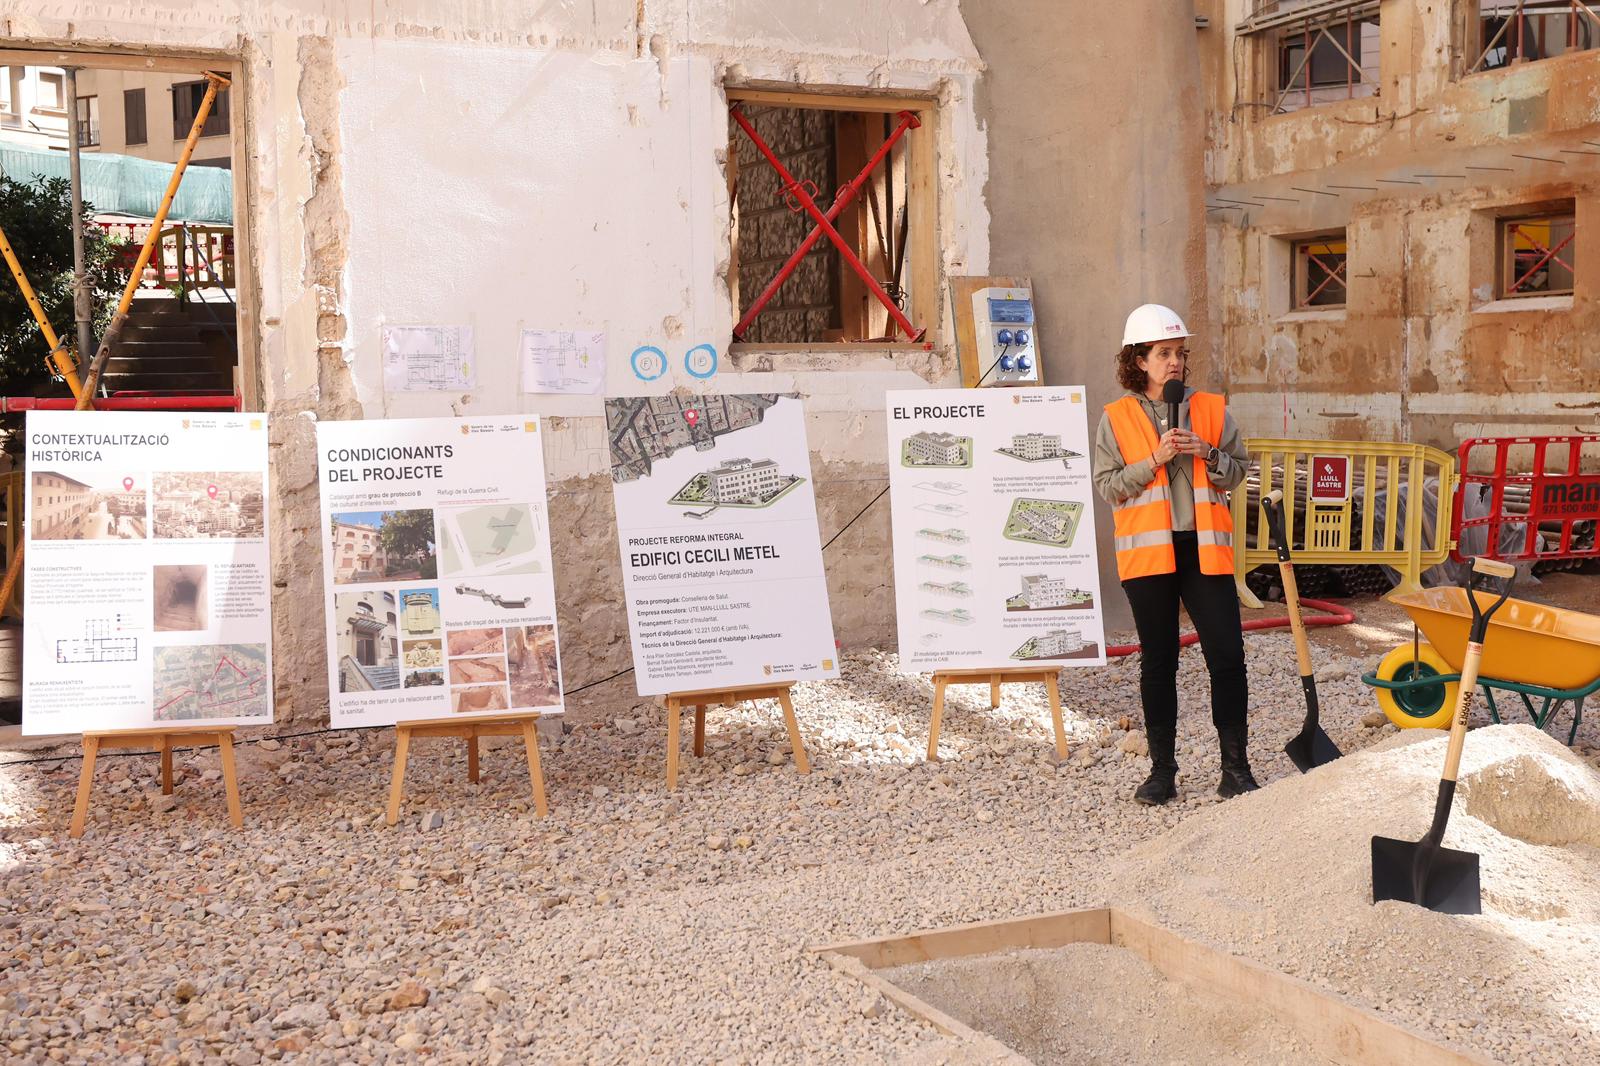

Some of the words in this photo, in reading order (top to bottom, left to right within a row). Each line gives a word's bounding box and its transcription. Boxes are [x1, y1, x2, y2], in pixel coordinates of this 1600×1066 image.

[894, 407, 910, 419] EL
[914, 405, 985, 419] PROJECTE
[32, 432, 169, 446] CONTEXTUALITZACIÓ
[32, 448, 102, 462] HISTÒRICA
[328, 445, 453, 463] CONDICIONANTS
[329, 468, 358, 482] DEL
[363, 465, 443, 481] PROJECTE
[1544, 482, 1600, 502] man
[628, 537, 668, 546] PROJECTE
[670, 534, 706, 544] REFORMA
[707, 532, 744, 542] INTEGRAL
[630, 551, 681, 567] EDIFICI
[685, 548, 730, 564] CECILI
[734, 545, 780, 560] METEL
[633, 573, 657, 582] Direcció
[658, 572, 681, 580] General
[682, 570, 715, 579] d'Habitatge
[719, 567, 754, 577] Arquitectura
